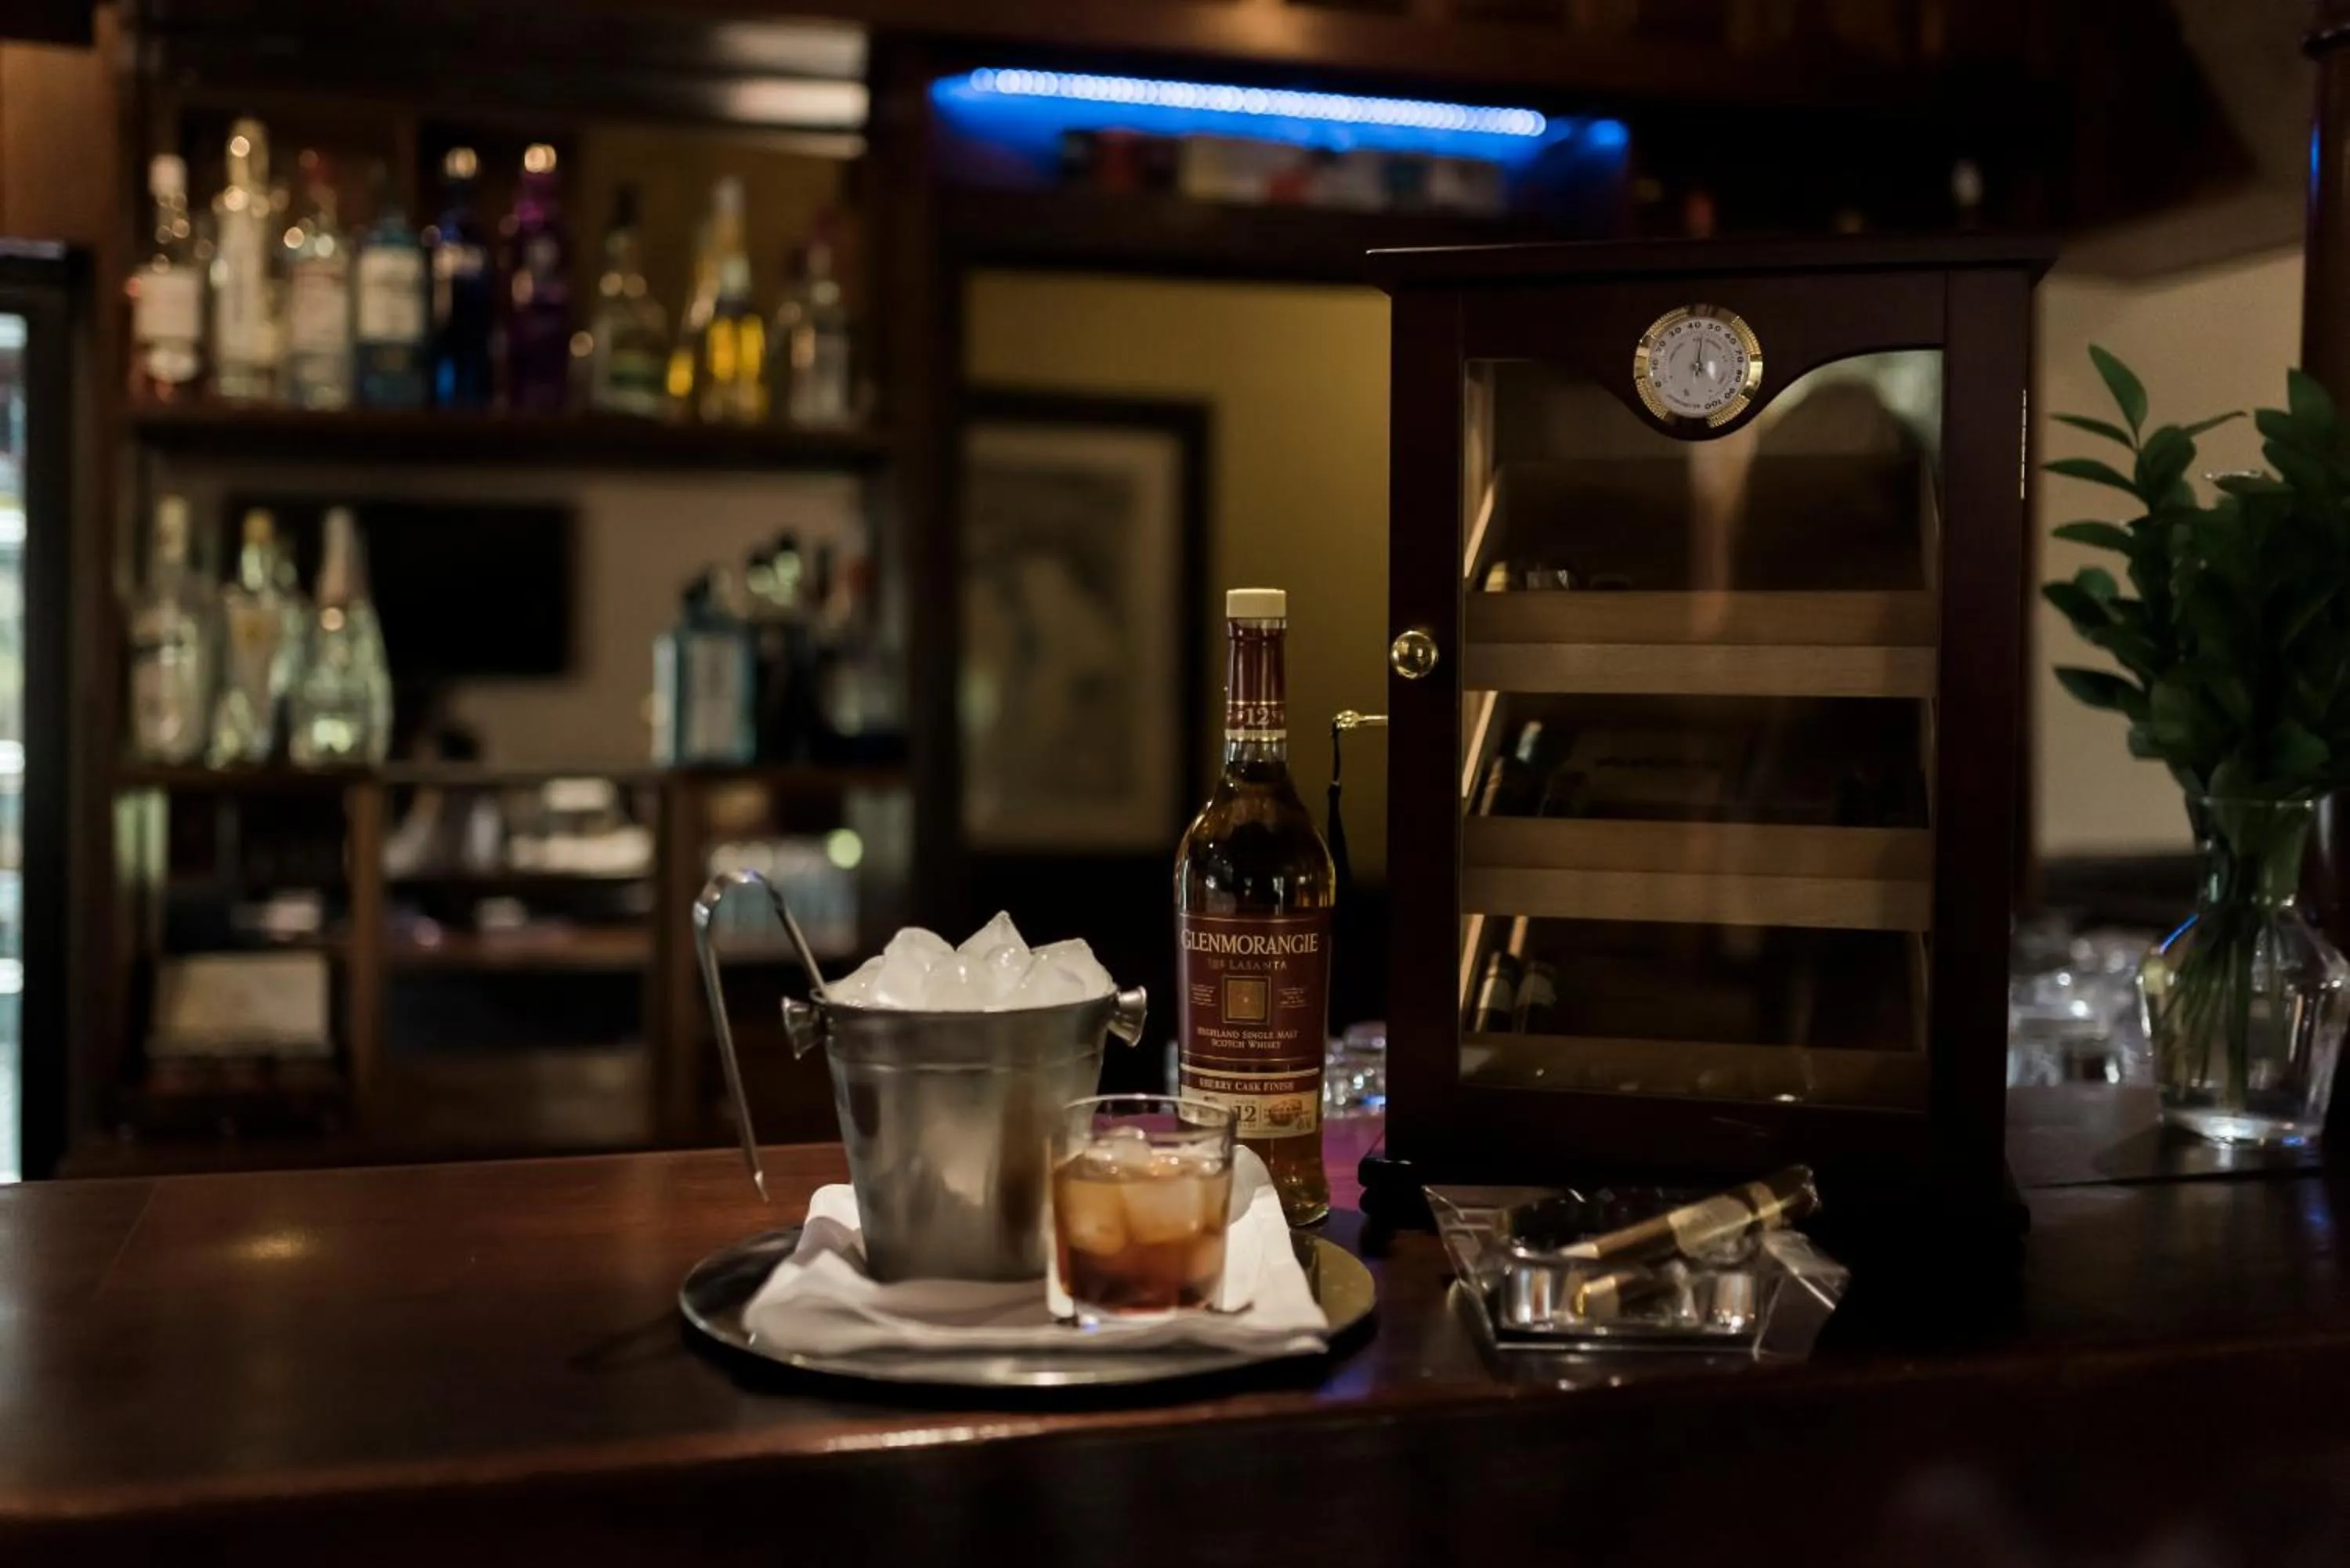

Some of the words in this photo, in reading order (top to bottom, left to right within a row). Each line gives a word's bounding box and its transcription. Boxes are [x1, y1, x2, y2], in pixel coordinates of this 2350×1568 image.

[1246, 706, 1270, 726] 12
[1180, 928, 1319, 955] GLENMORANGIE
[1242, 1030, 1274, 1039] SINGLE
[1211, 1038, 1246, 1049] SCOTCH
[1235, 1080, 1261, 1092] CASK
[1235, 1104, 1257, 1122] 12
